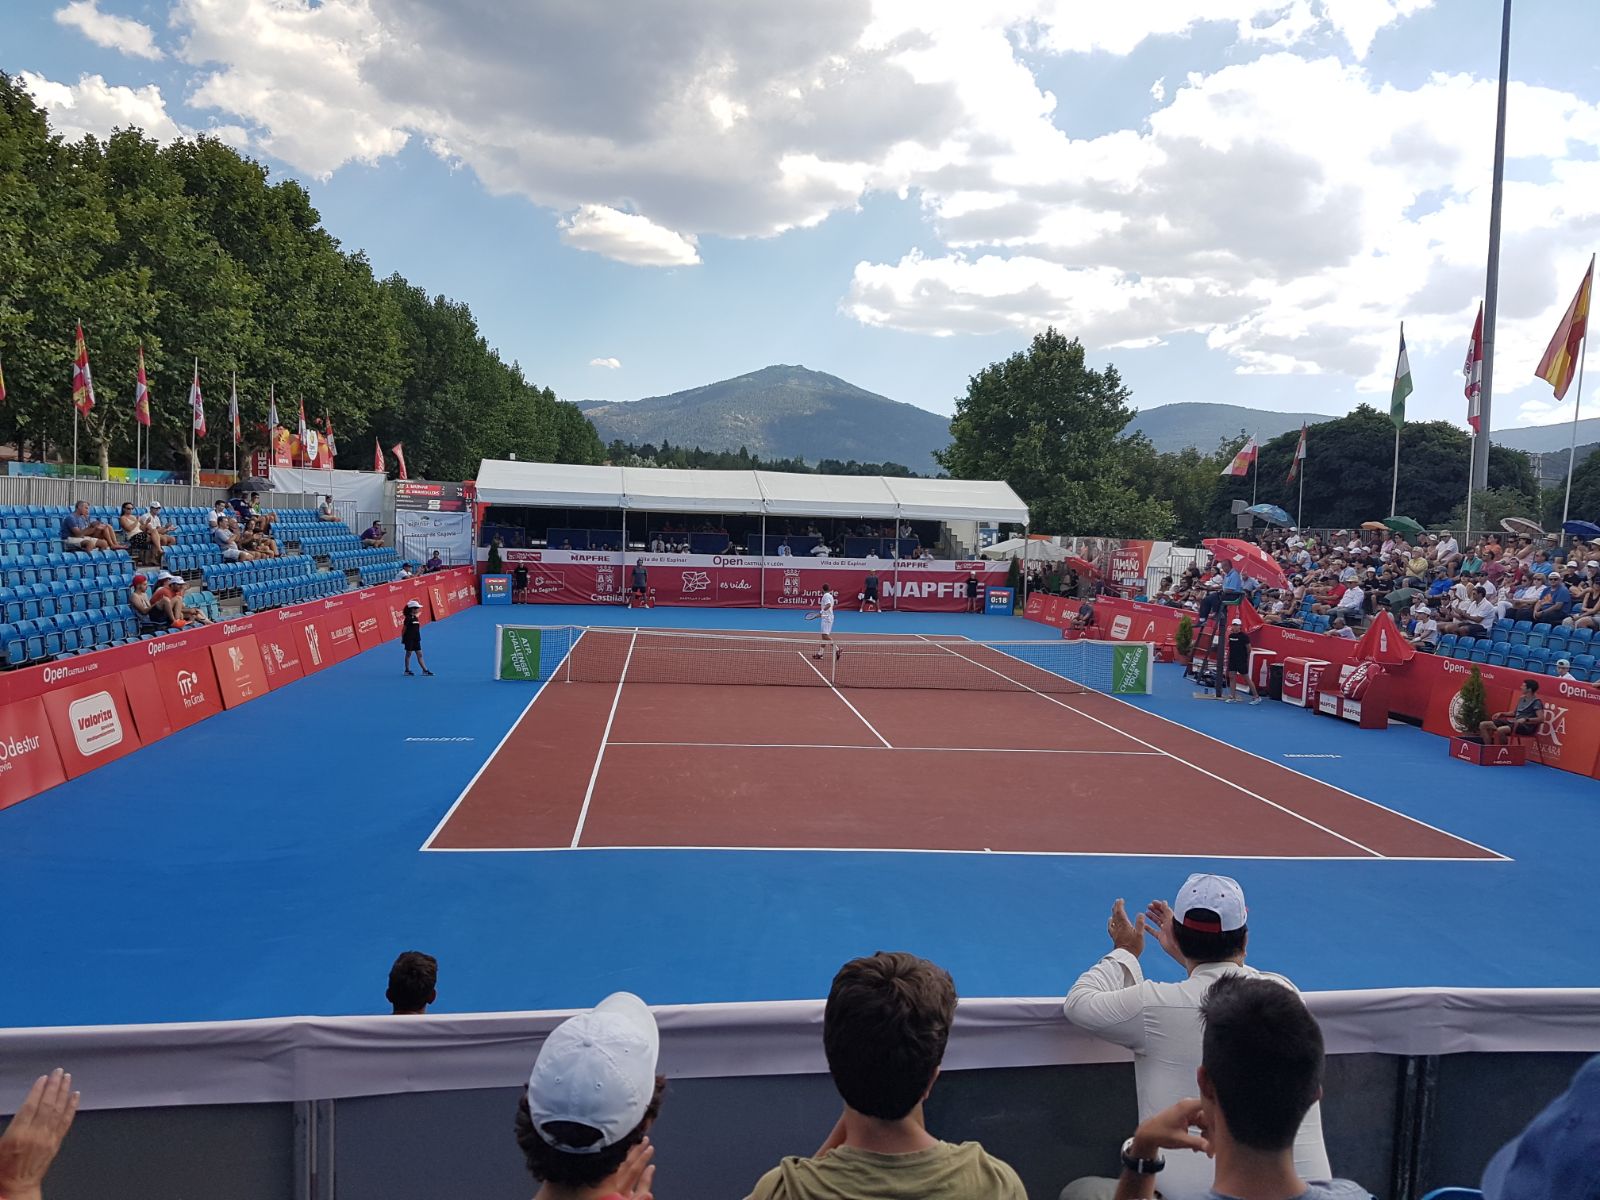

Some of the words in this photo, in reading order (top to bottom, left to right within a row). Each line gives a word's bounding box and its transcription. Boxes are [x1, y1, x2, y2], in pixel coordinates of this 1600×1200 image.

[713, 555, 743, 567] Open
[1112, 557, 1140, 571] TAMAÑO
[720, 581, 729, 589] es
[729, 579, 752, 589] vida
[778, 596, 808, 604] Castilla
[990, 596, 1008, 604] 0:18
[223, 623, 237, 637] Open
[1281, 629, 1296, 640] Open
[148, 642, 166, 656] Open
[508, 630, 531, 678] CHALLENGER
[520, 637, 533, 655] ATP
[510, 652, 522, 673] TOUR
[1120, 647, 1144, 693] CHALLENGER
[1121, 652, 1131, 671] ATP
[1443, 659, 1465, 674] Open
[43, 667, 68, 684] Open
[1128, 668, 1141, 688] TOUR
[179, 677, 192, 696] ITF
[1559, 682, 1587, 699] Open
[78, 708, 113, 731] Valoriza
